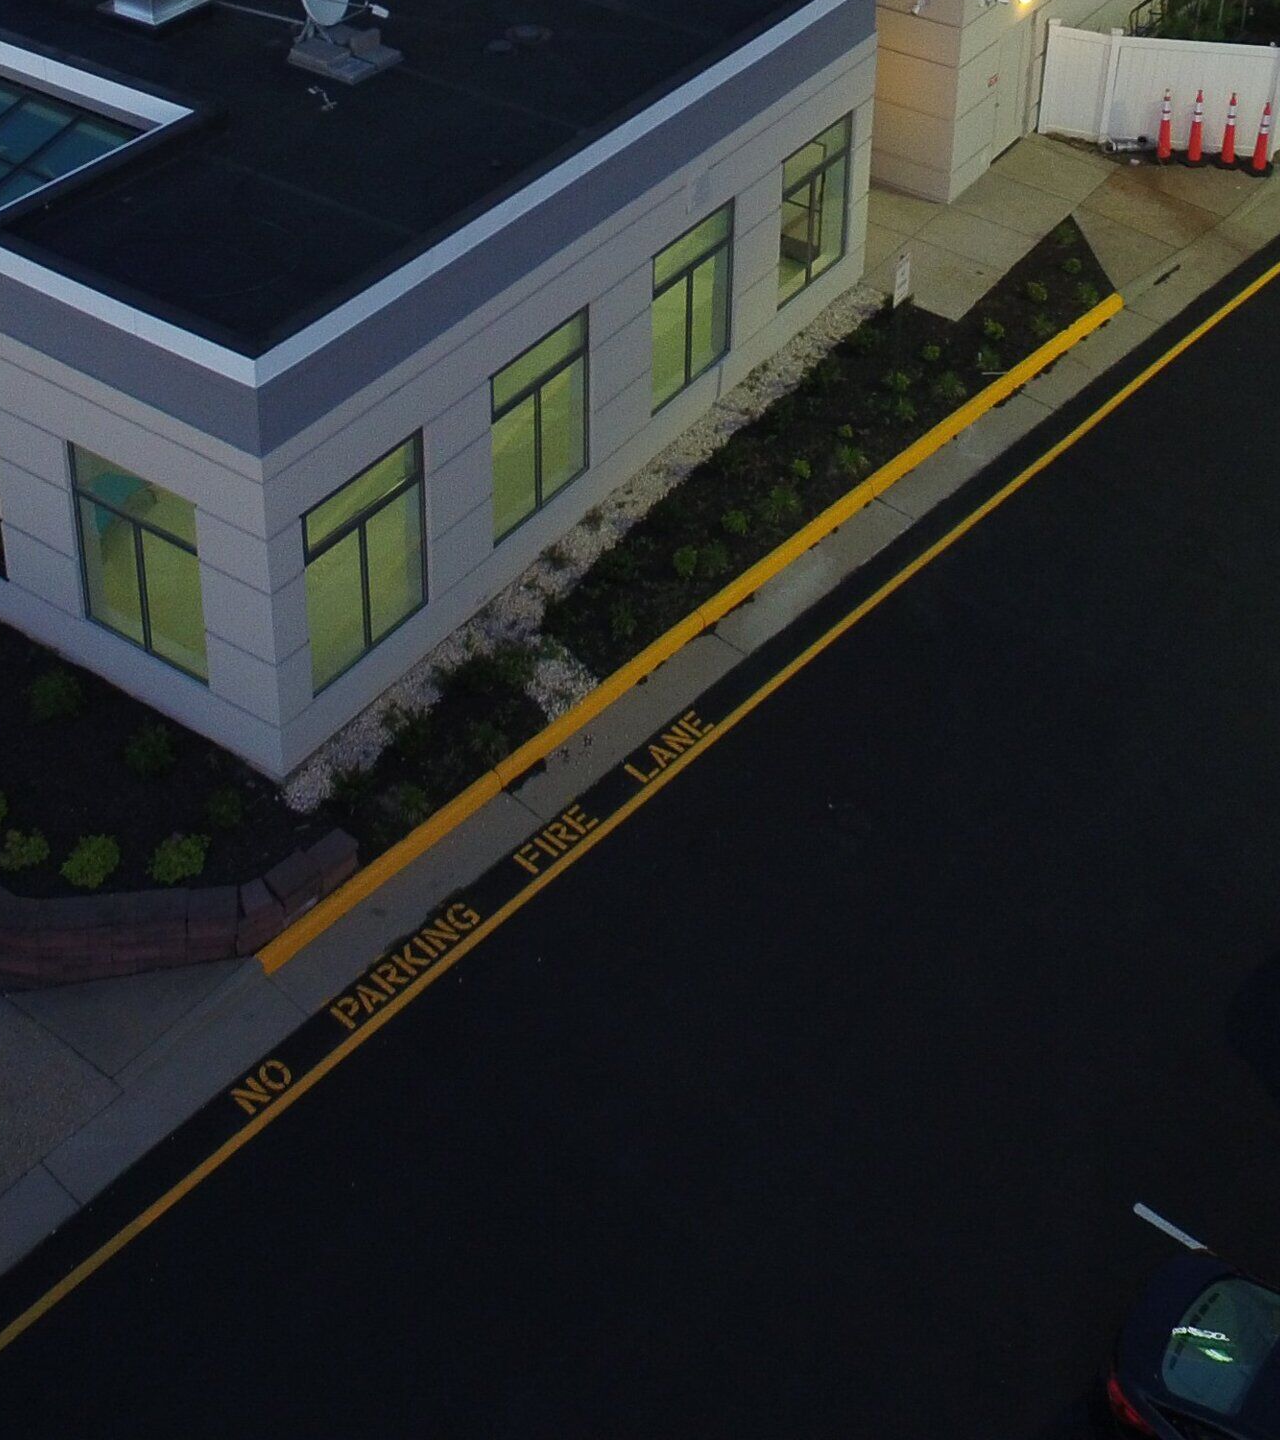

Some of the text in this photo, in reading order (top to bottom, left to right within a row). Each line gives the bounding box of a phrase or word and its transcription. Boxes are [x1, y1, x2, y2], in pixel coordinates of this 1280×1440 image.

[230, 709, 714, 1116] NO PARKING FIRE LANE
